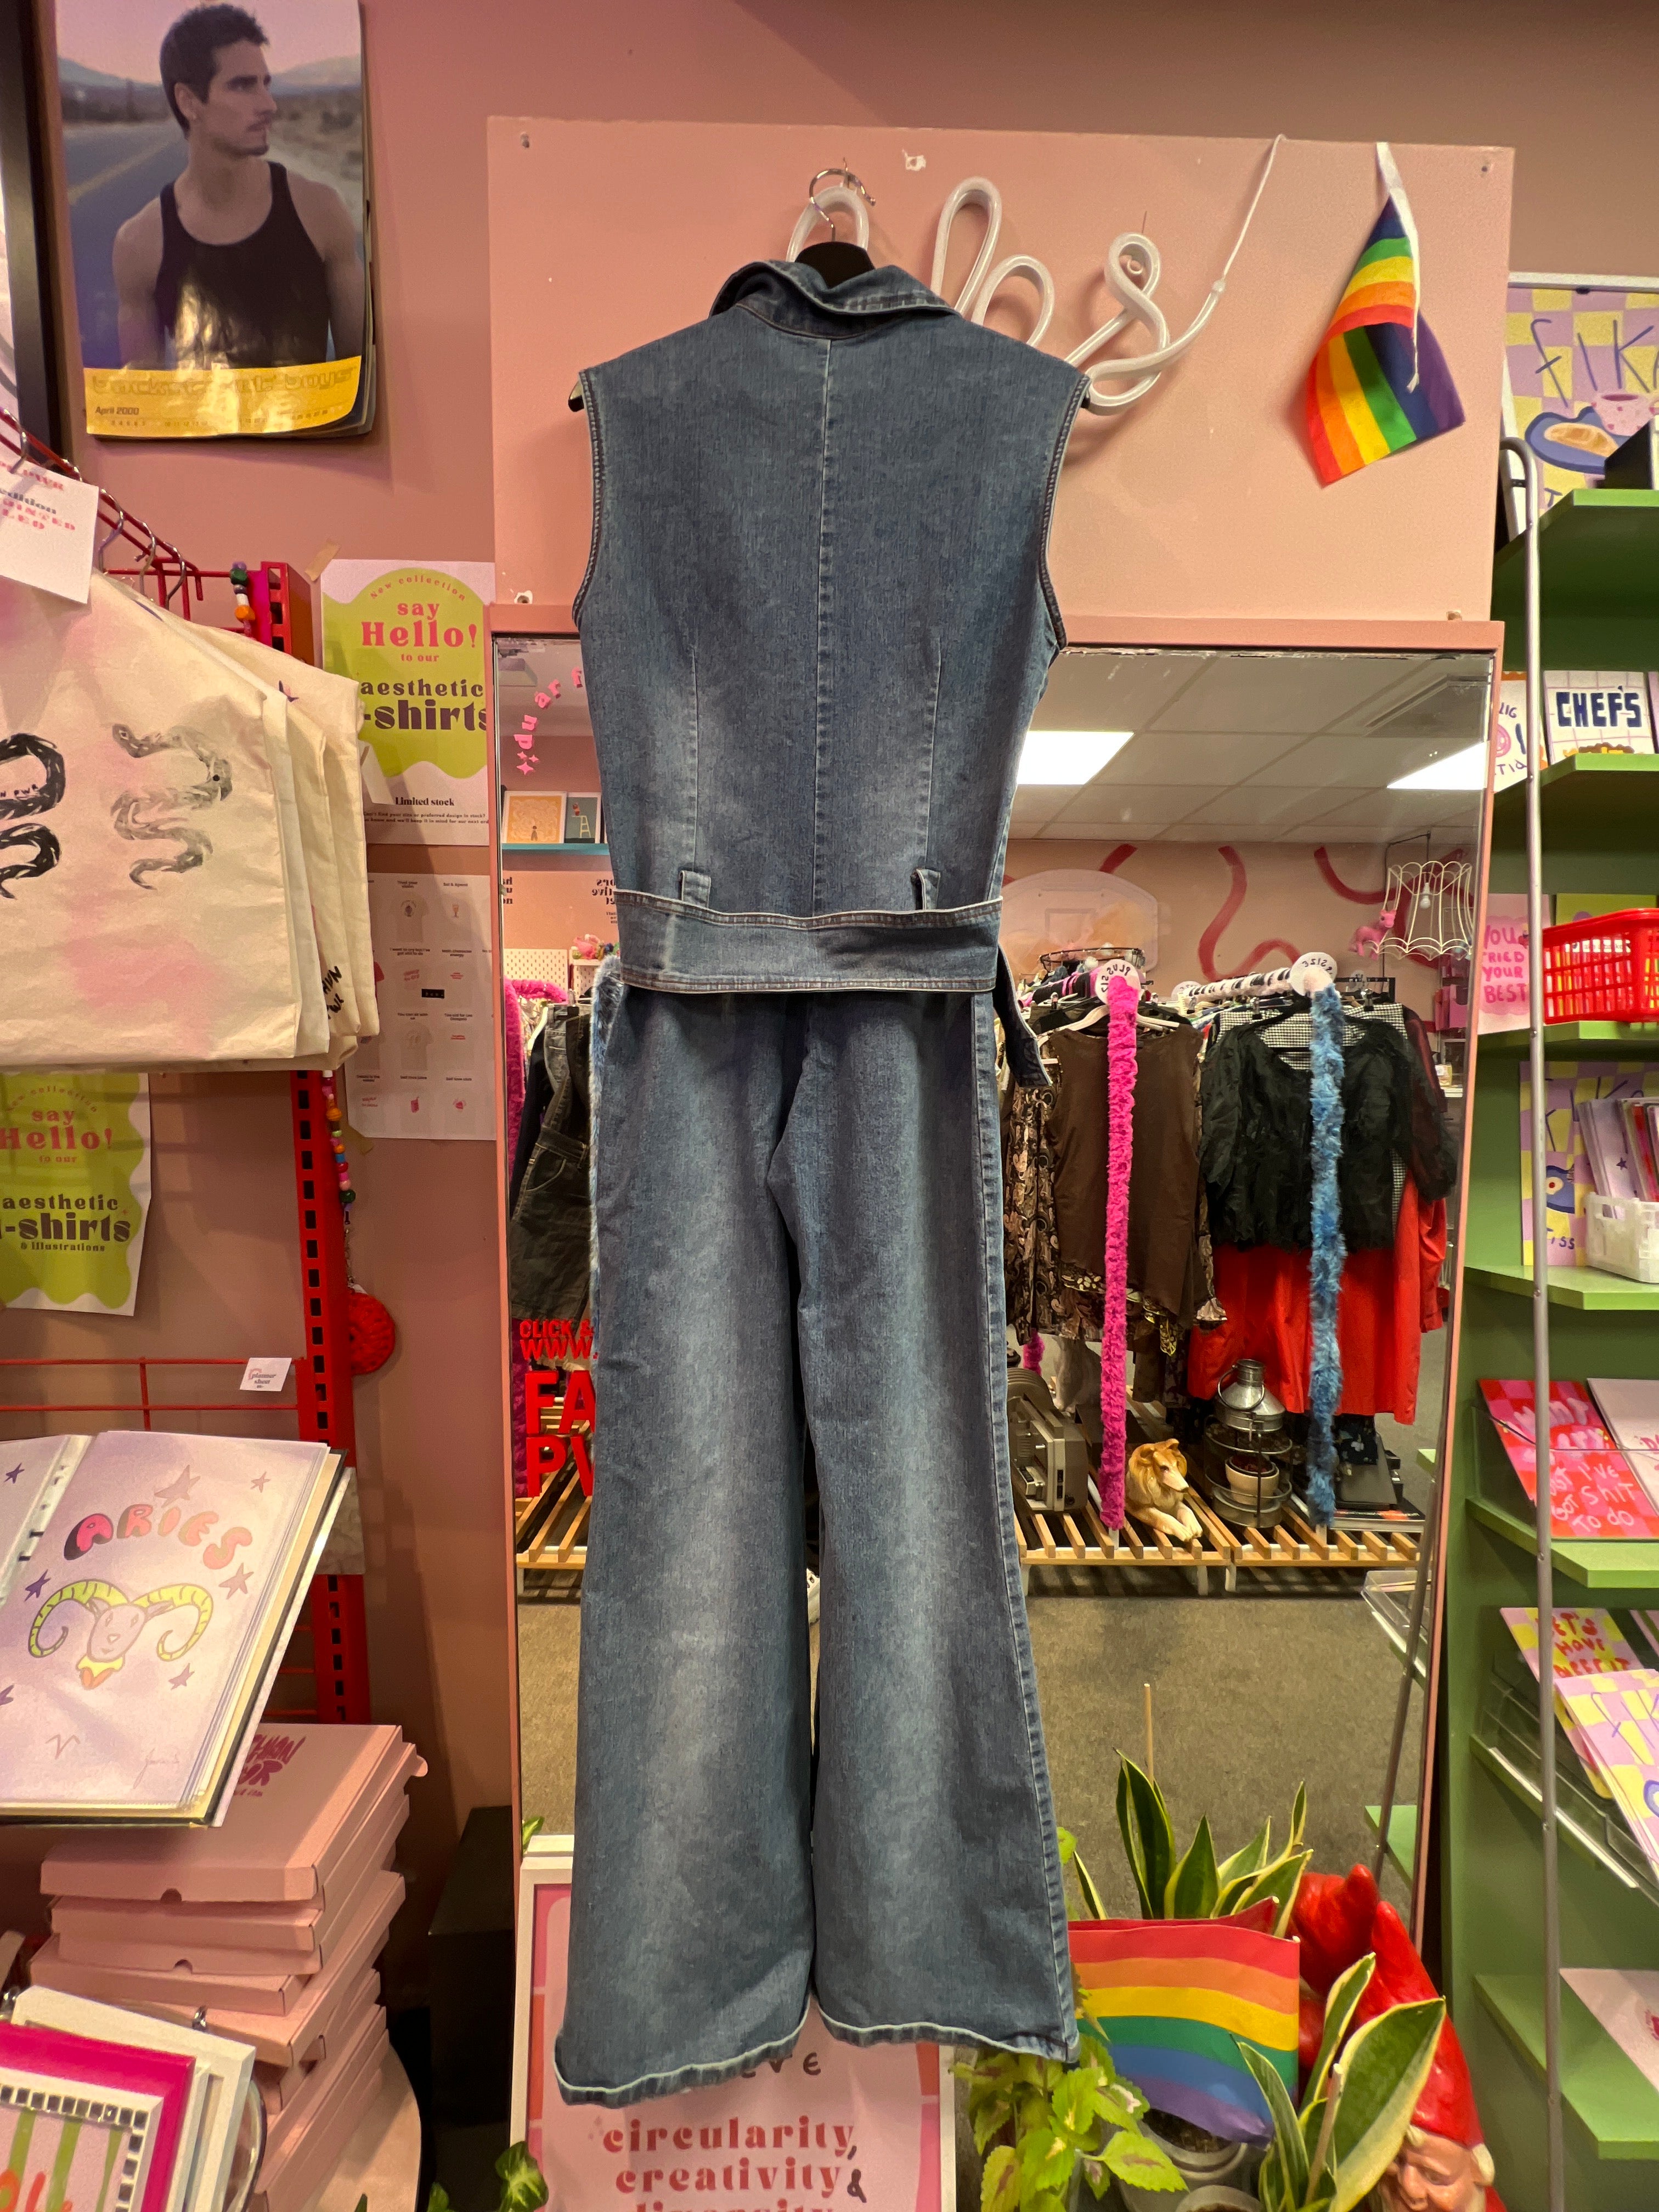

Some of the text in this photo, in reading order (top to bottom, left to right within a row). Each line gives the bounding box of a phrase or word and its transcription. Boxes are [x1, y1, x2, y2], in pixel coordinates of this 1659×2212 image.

[95, 406, 139, 415] April 2000
[398, 574, 465, 601] collection
[397, 603, 440, 620] say
[361, 619, 477, 648] Hello!
[400, 653, 439, 662] to our
[360, 678, 483, 697] aesthetic
[364, 698, 486, 731] -shirt
[1556, 685, 1643, 727] CHEF'S
[395, 797, 455, 806] Limited stock
[1483, 966, 1523, 982] YOUR
[1484, 983, 1527, 1003] BEST
[32, 1110, 75, 1126] say
[0, 1126, 112, 1150] Hello!
[3, 1193, 119, 1210] aesthetic
[0, 1211, 131, 1242] -shirts
[520, 1318, 595, 1339] CLICK &
[63, 1503, 253, 1570] ARIES
[616, 2156, 840, 2199] creativity
